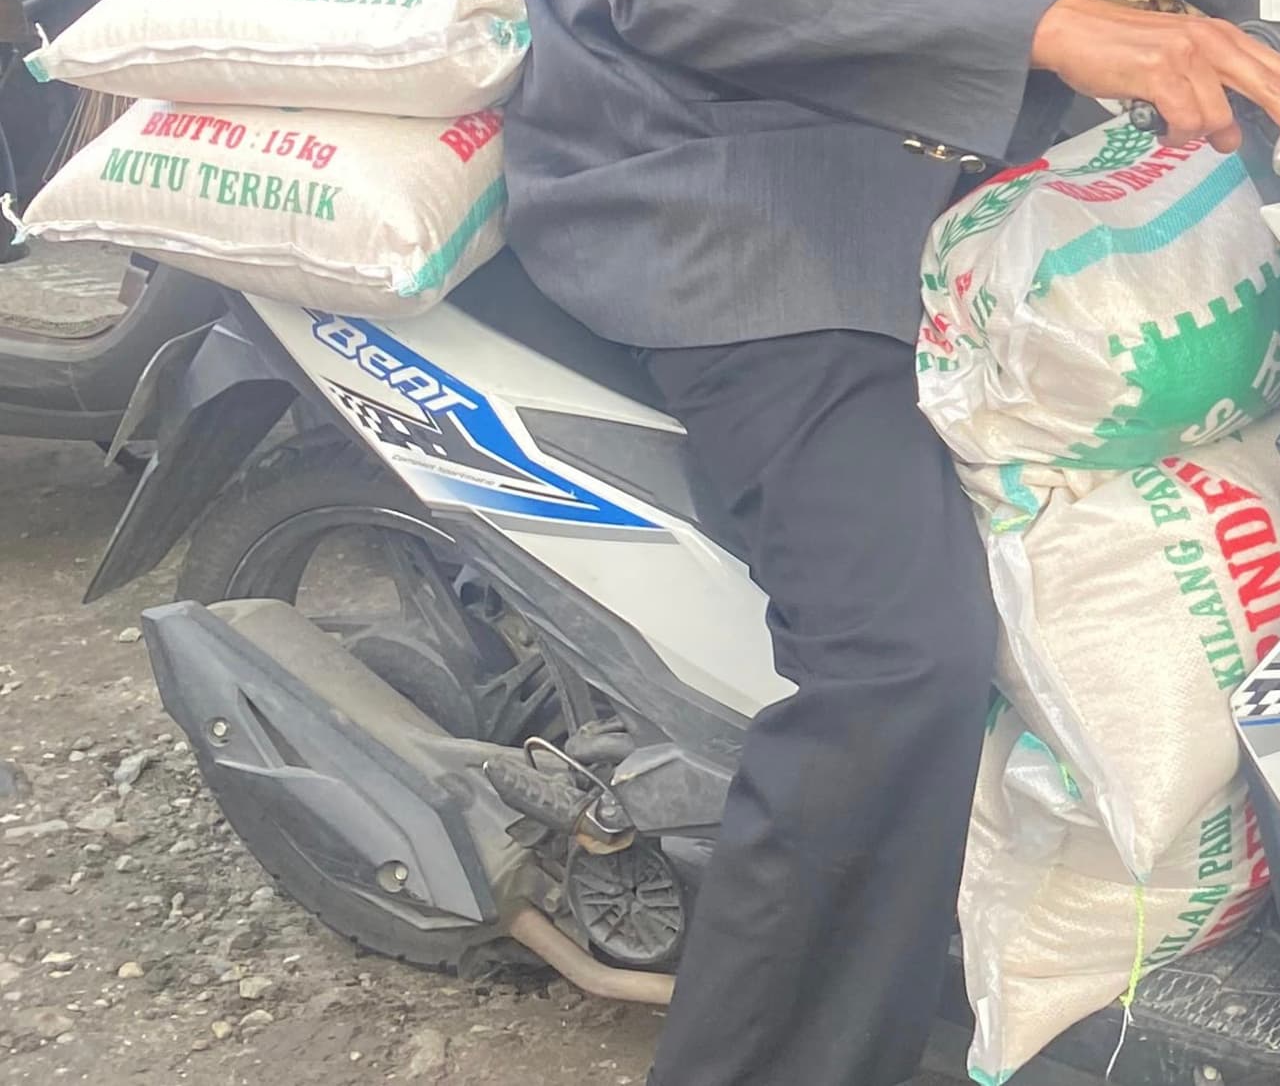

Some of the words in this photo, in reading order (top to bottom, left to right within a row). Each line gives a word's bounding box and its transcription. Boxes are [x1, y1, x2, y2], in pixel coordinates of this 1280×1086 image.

[140, 111, 247, 150] BRUTTO
[100, 148, 190, 193] MUTU
[198, 161, 345, 222] TERBAIK
[1163, 538, 1247, 691] KILANG
